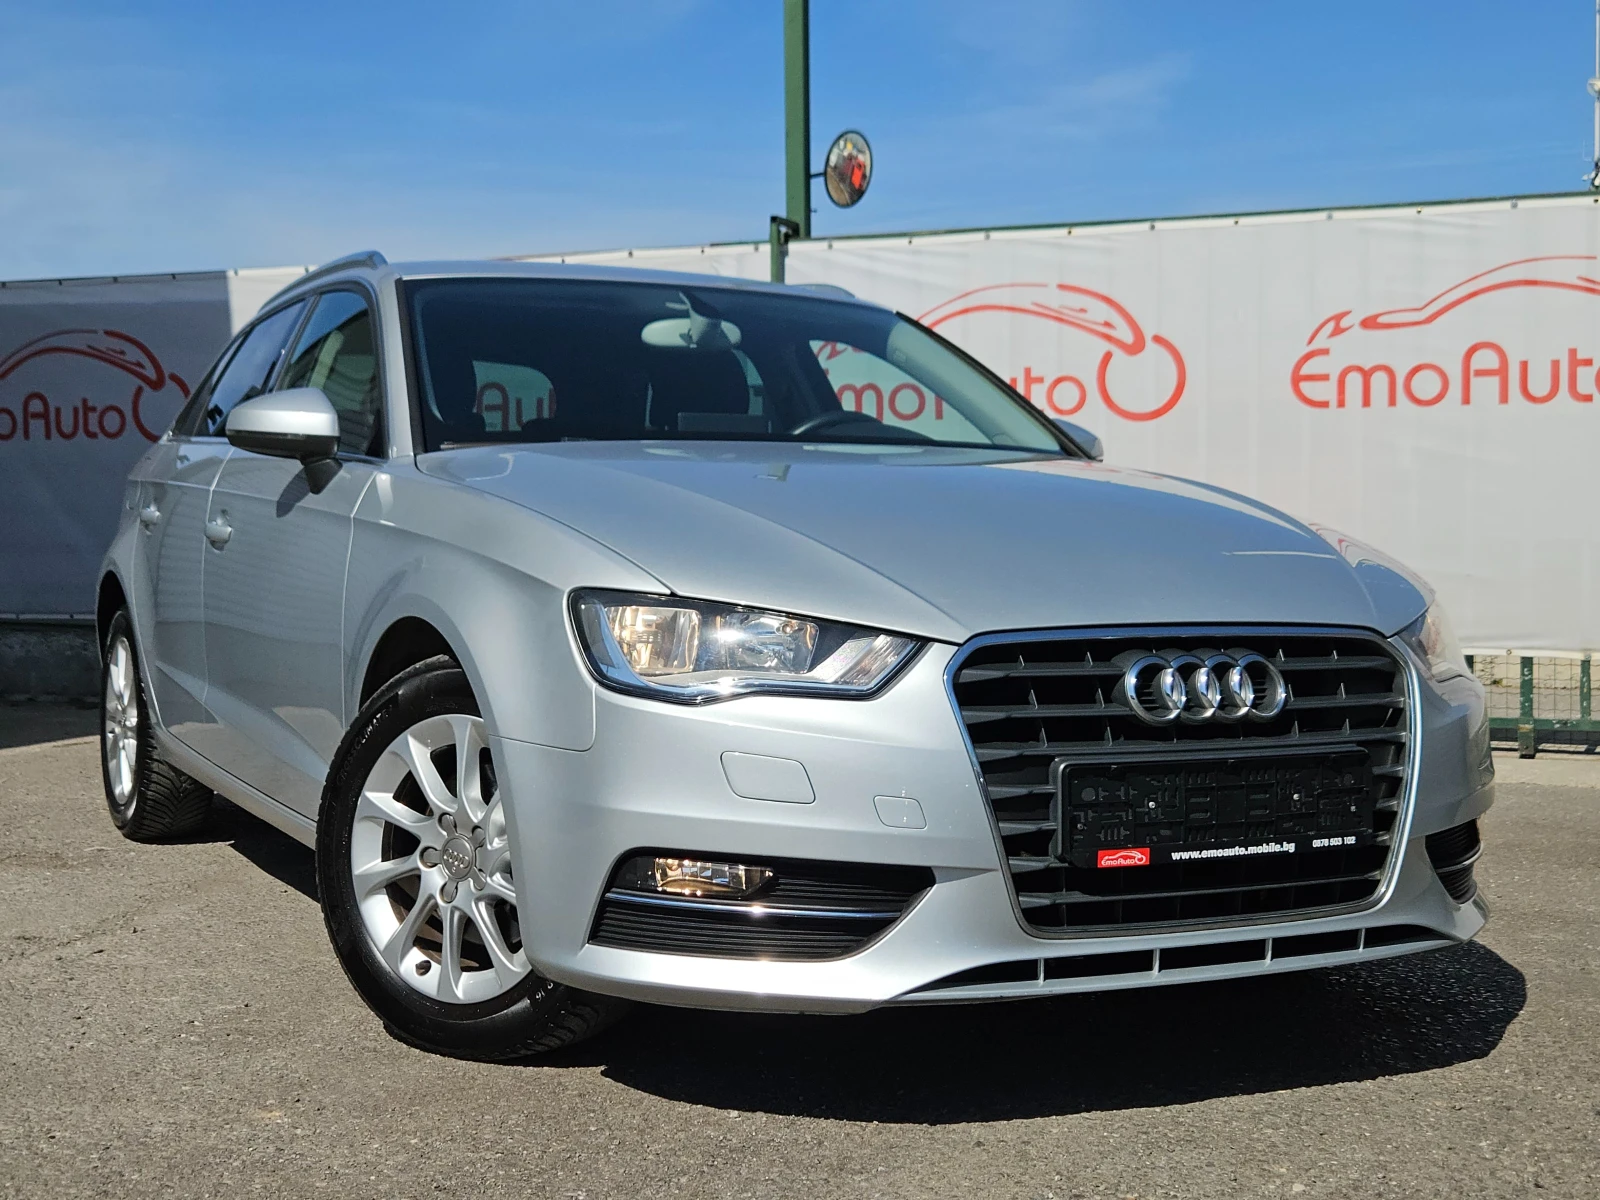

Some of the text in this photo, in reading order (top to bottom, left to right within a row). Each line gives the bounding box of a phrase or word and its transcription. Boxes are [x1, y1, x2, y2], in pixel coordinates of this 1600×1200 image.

[1290, 340, 1600, 409] EmoAut
[1101, 857, 1135, 866] EmoAuto
[1171, 842, 1296, 860] www.emoauto.mobile.bg
